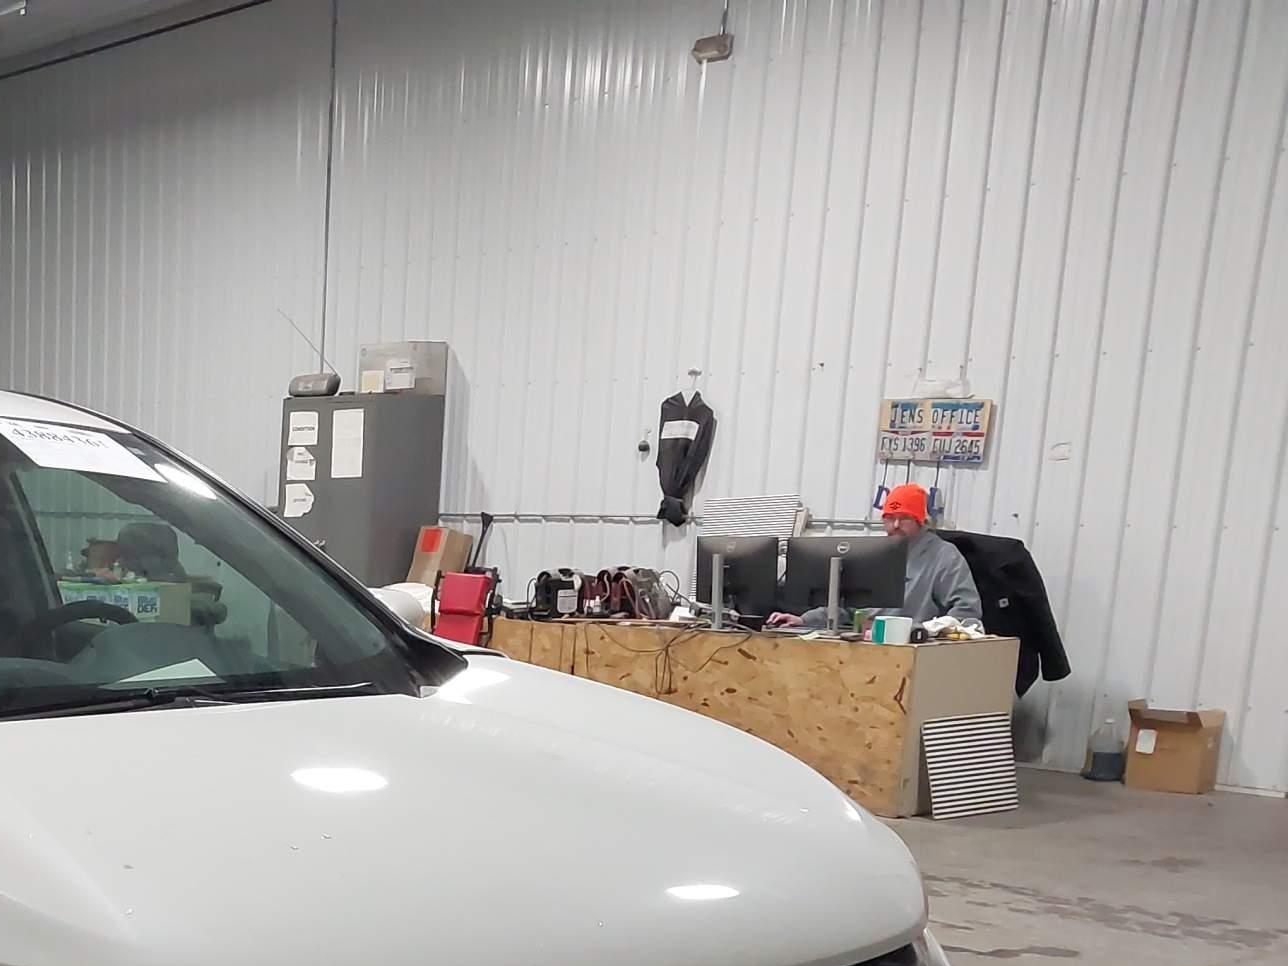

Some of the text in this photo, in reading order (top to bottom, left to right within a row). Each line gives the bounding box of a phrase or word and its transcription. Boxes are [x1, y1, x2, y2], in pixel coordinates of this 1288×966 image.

[890, 408, 980, 425] JENS OFFICE
[903, 437, 927, 452] 1396
[954, 438, 981, 455] 2645
